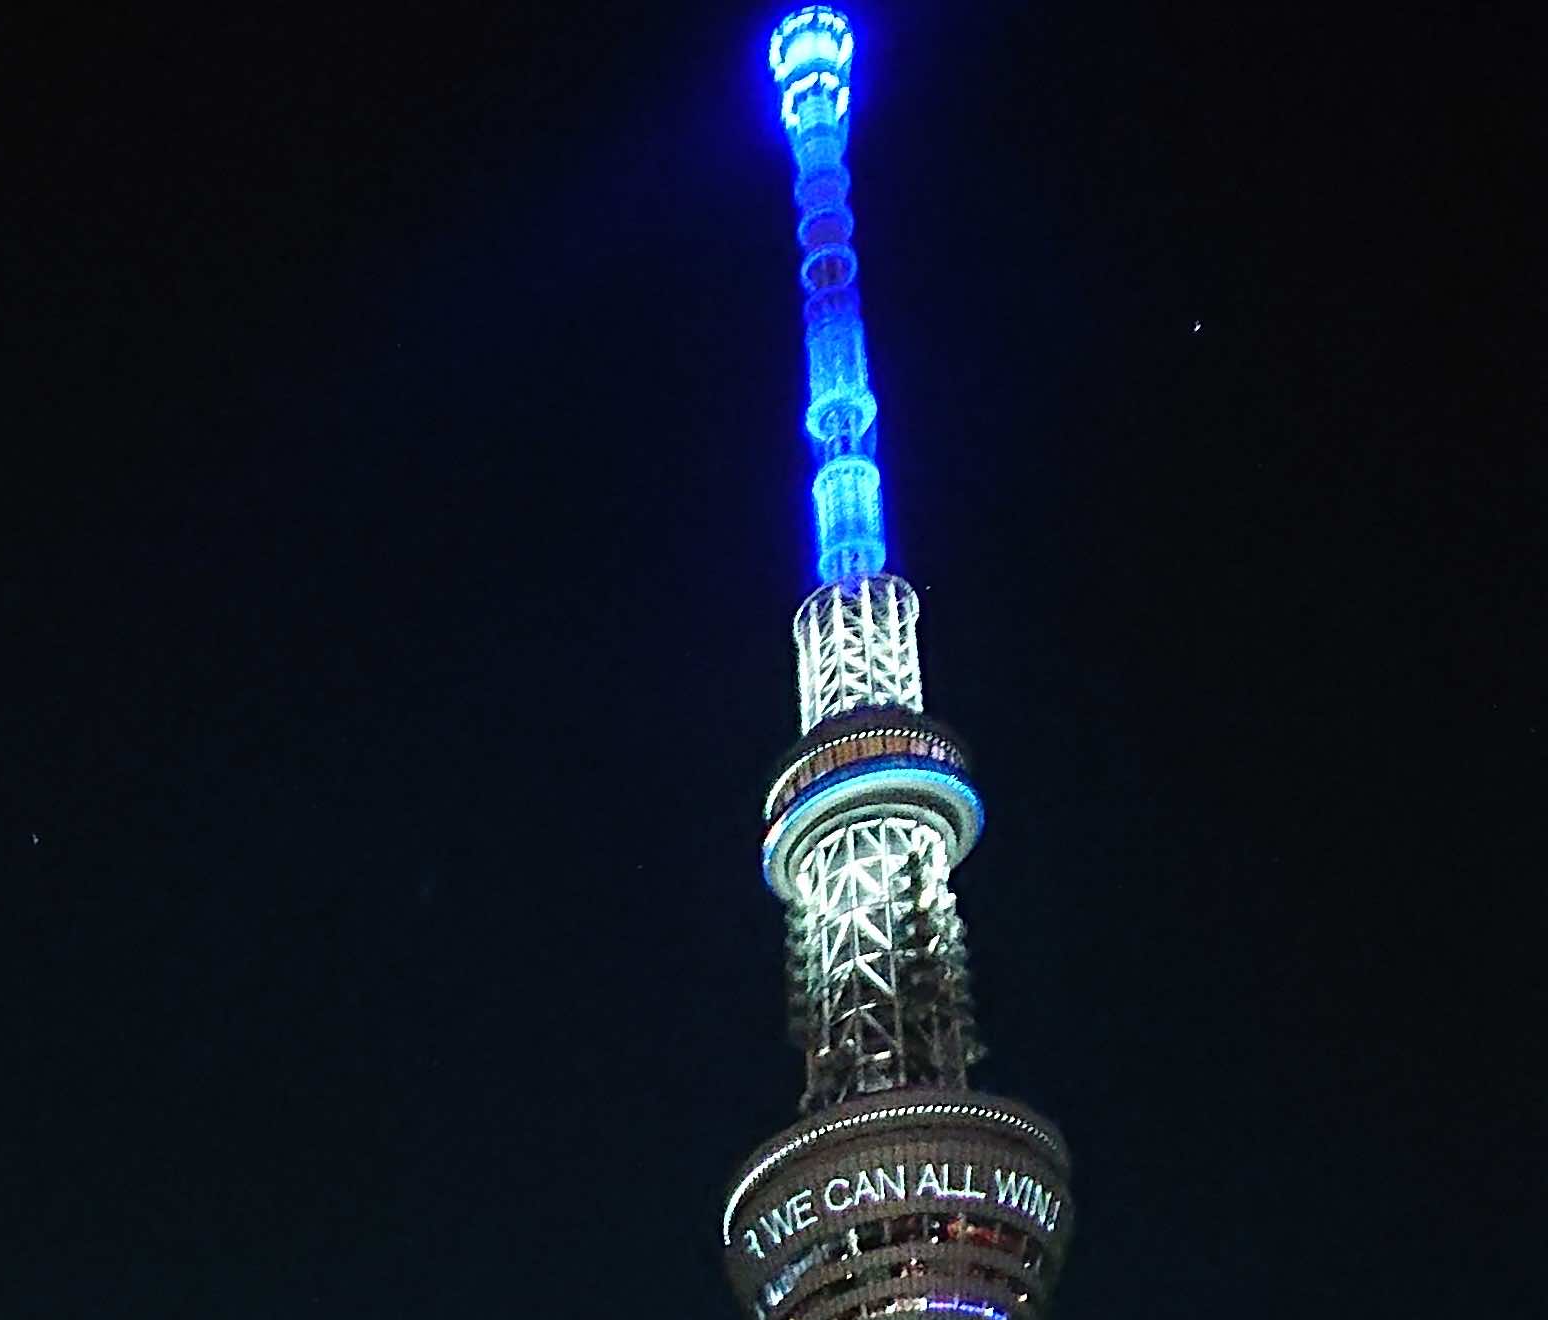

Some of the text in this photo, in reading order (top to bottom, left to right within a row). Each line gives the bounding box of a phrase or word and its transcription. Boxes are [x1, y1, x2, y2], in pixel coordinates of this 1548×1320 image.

[758, 1189, 819, 1244] WE
[823, 1164, 906, 1211] CAN
[916, 1163, 986, 1199] ALL
[994, 1168, 1061, 1232] WIN!
